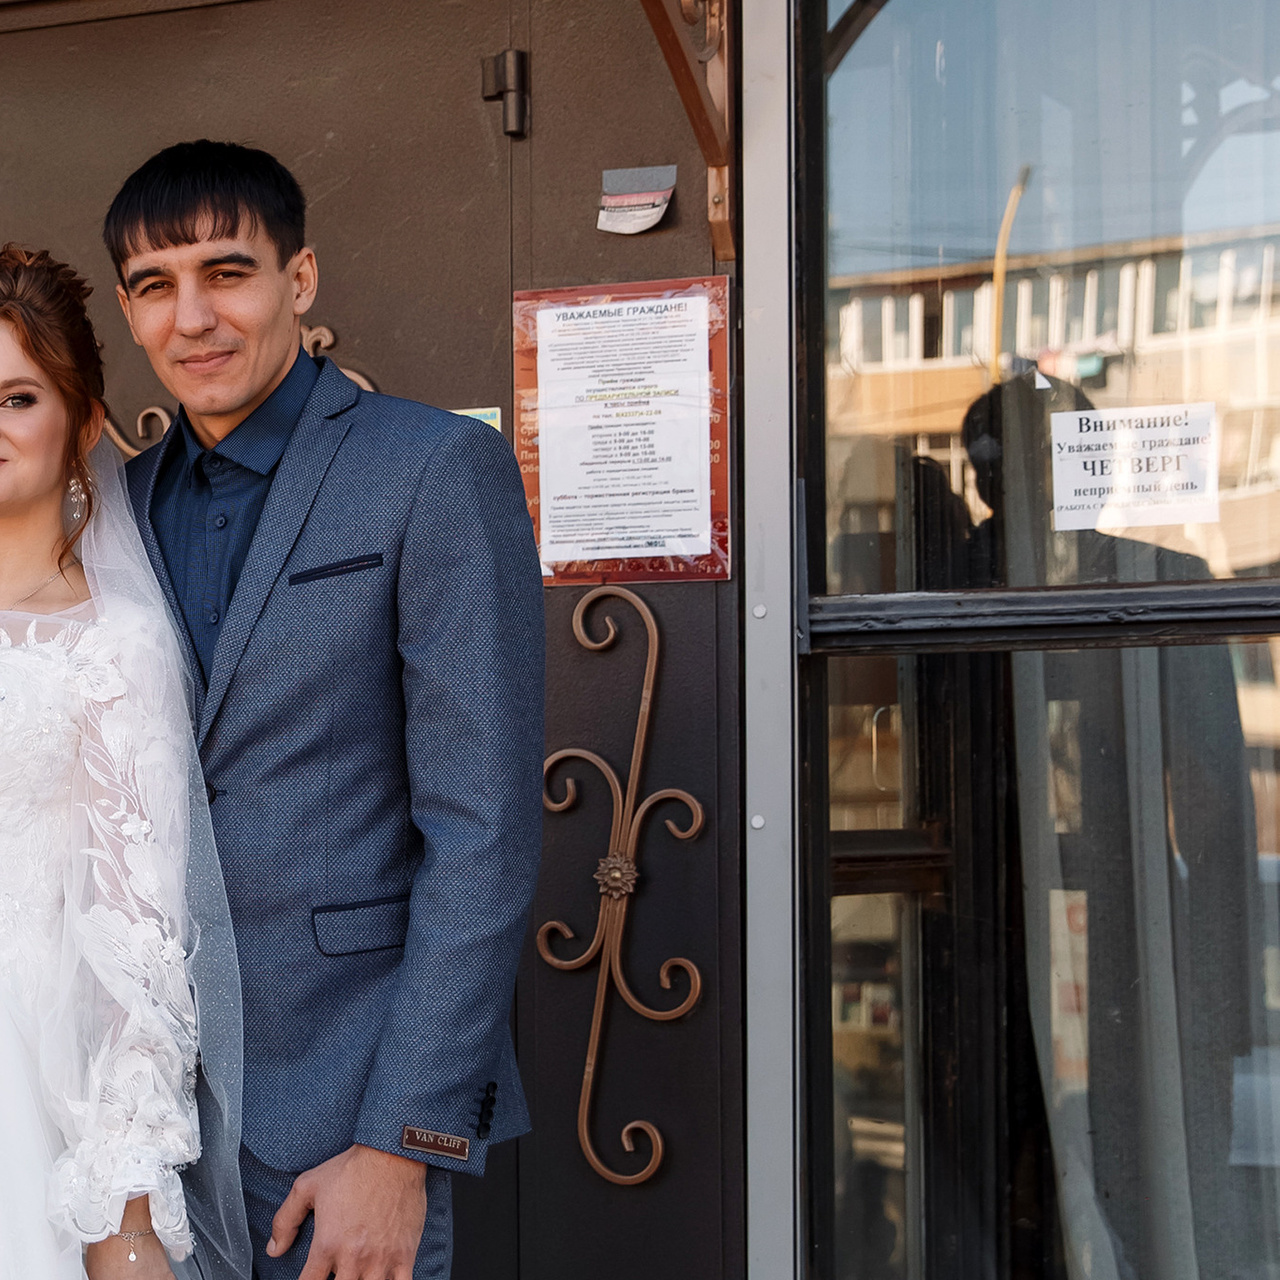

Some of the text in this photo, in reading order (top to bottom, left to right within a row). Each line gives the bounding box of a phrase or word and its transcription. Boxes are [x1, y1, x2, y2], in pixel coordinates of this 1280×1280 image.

[555, 302, 688, 322] УВАЖАЕМЫЕ ГРАЖДАНЕ!
[1077, 410, 1189, 434] Внимание!
[1056, 441, 1138, 455] Уважаеме
[415, 1131, 462, 1149] VAN CLIFF
